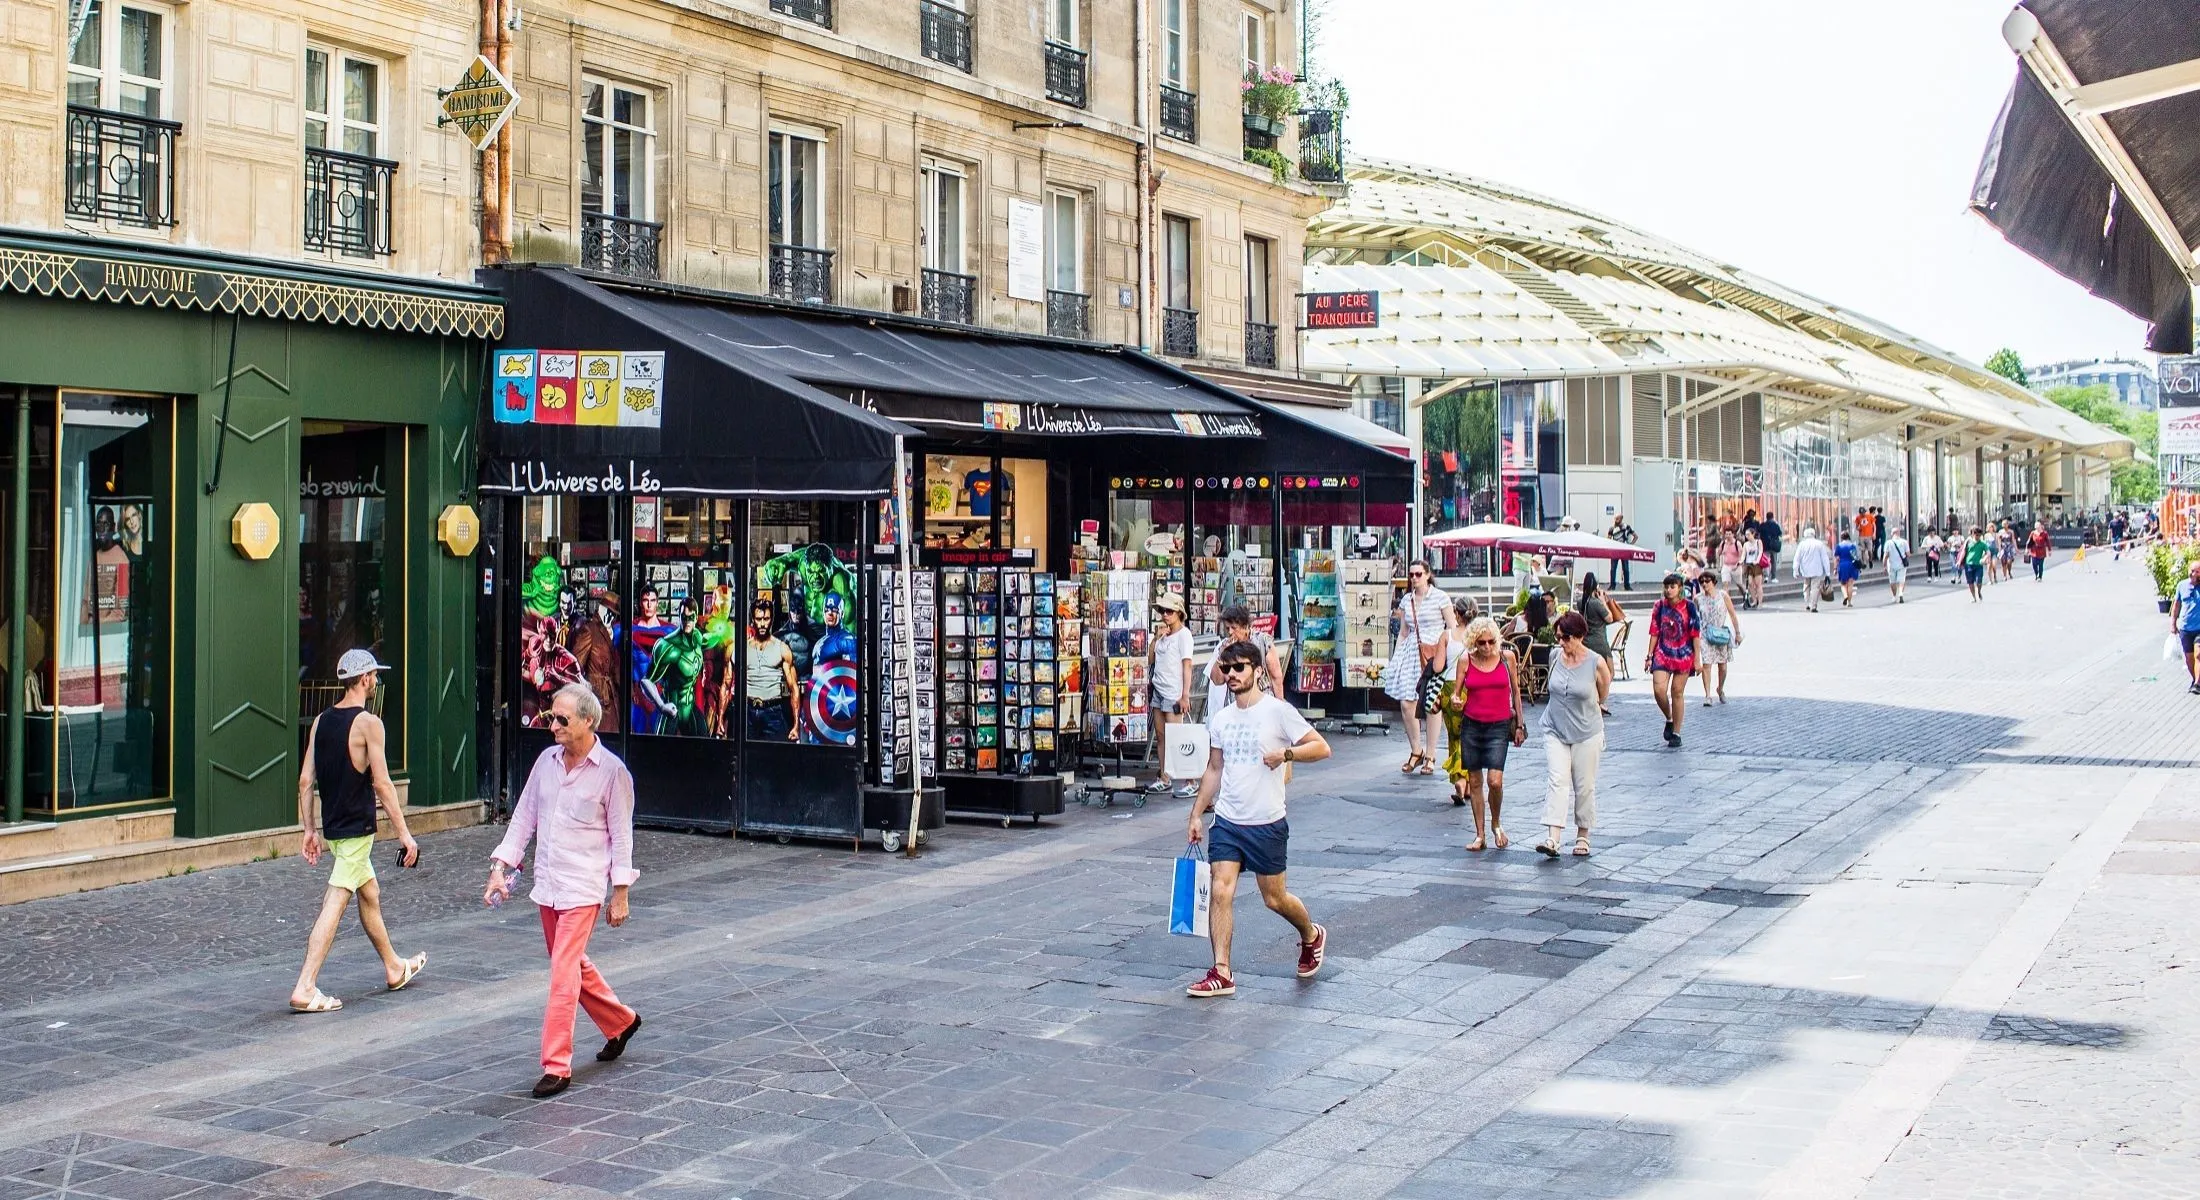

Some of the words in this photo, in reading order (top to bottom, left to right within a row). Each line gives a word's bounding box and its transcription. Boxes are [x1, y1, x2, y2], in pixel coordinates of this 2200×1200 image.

[448, 91, 507, 113] HANDSOME
[105, 263, 197, 293] HANDSOME
[1316, 295, 1332, 309] AU
[1308, 311, 1376, 326] TRANQUILLE
[2162, 371, 2200, 394] val
[1026, 403, 1073, 433] L'Univers
[1072, 411, 1086, 433] de
[1081, 408, 1102, 433] Léo
[511, 460, 598, 493] L'Univers
[601, 463, 624, 493] de
[629, 459, 661, 493] Léo
[979, 551, 988, 561] in
[991, 551, 1007, 561] air
